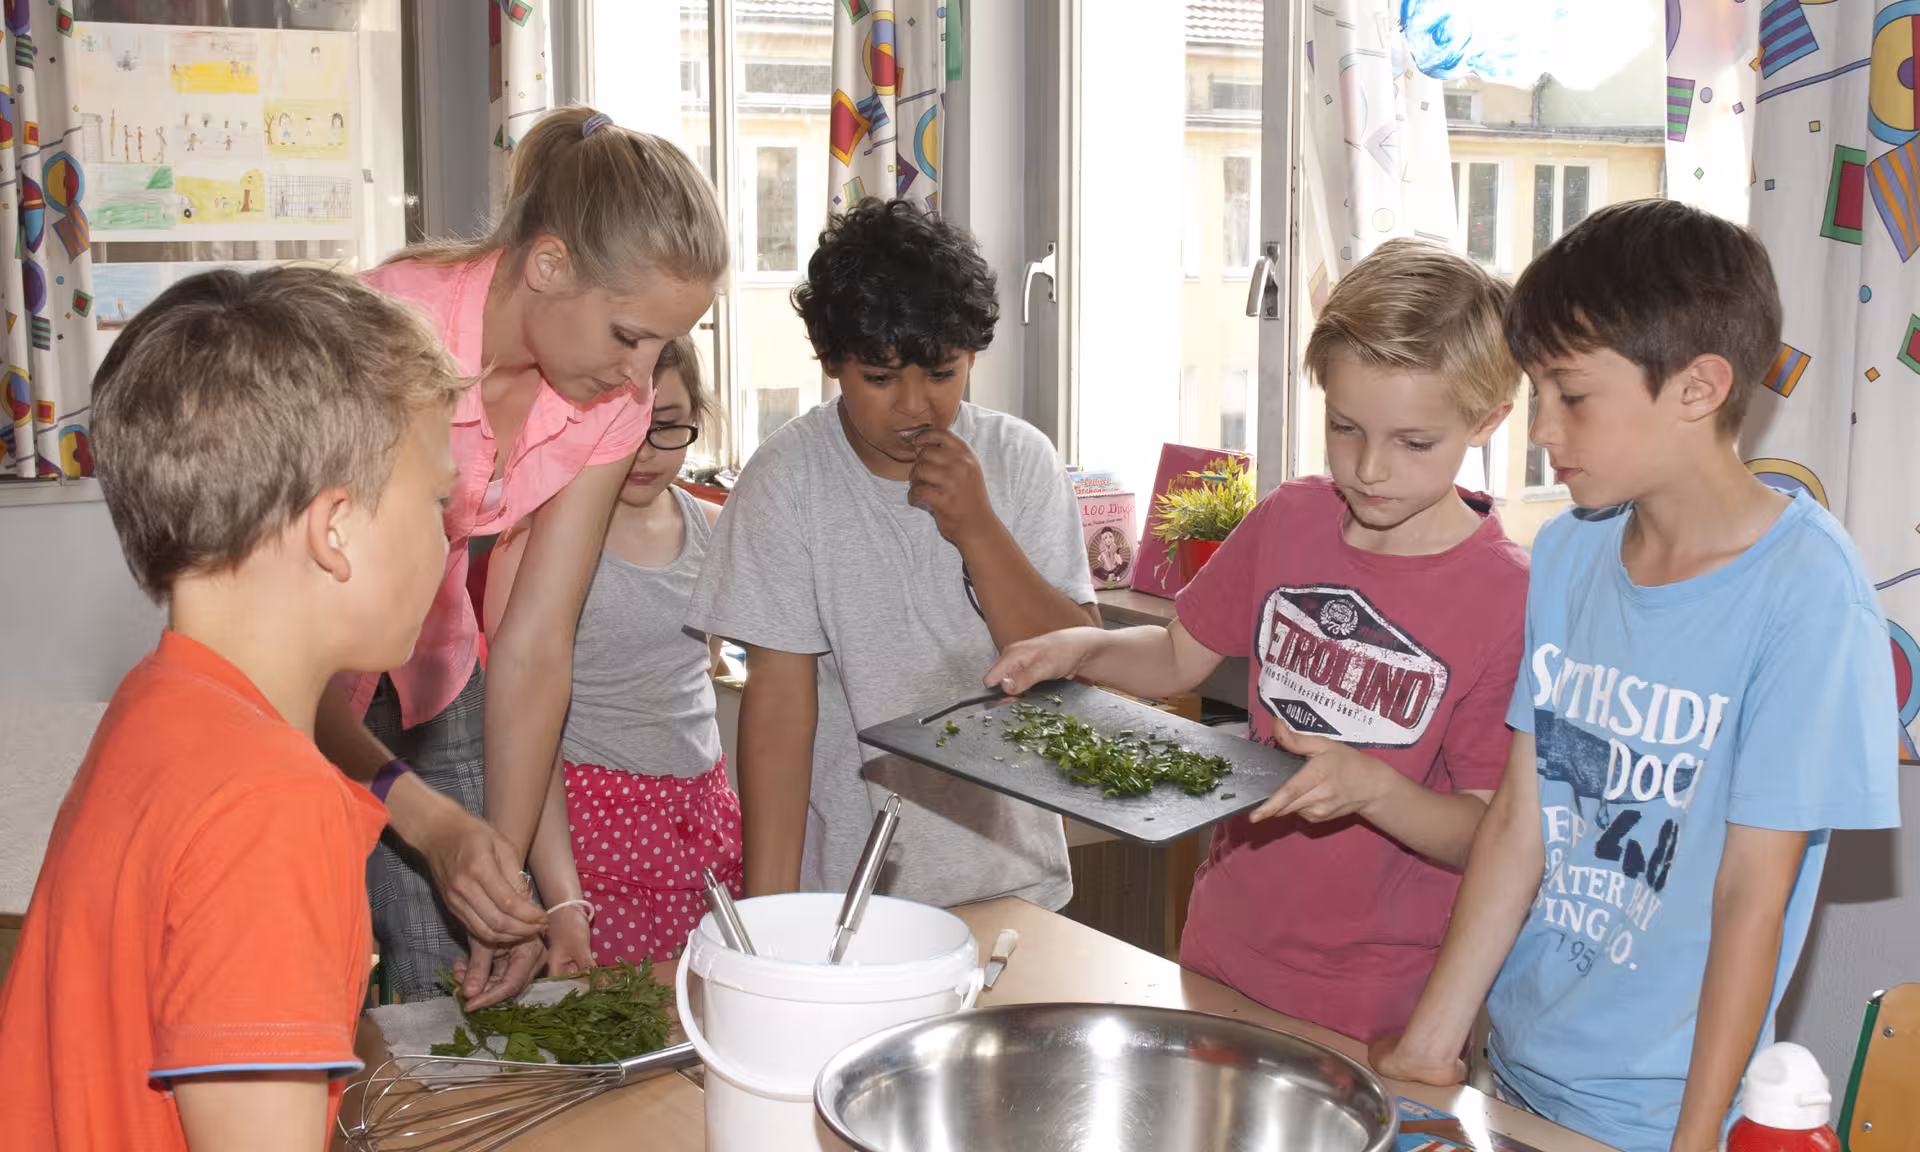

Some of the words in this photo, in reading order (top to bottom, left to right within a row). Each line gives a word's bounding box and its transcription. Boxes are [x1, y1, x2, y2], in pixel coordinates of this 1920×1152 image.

[1083, 504, 1105, 516] 100
[1108, 503, 1135, 519] Dinge
[1285, 703, 1317, 728] QUALIFY
[1546, 863, 1625, 908] ATER
[1539, 896, 1610, 941] ING
